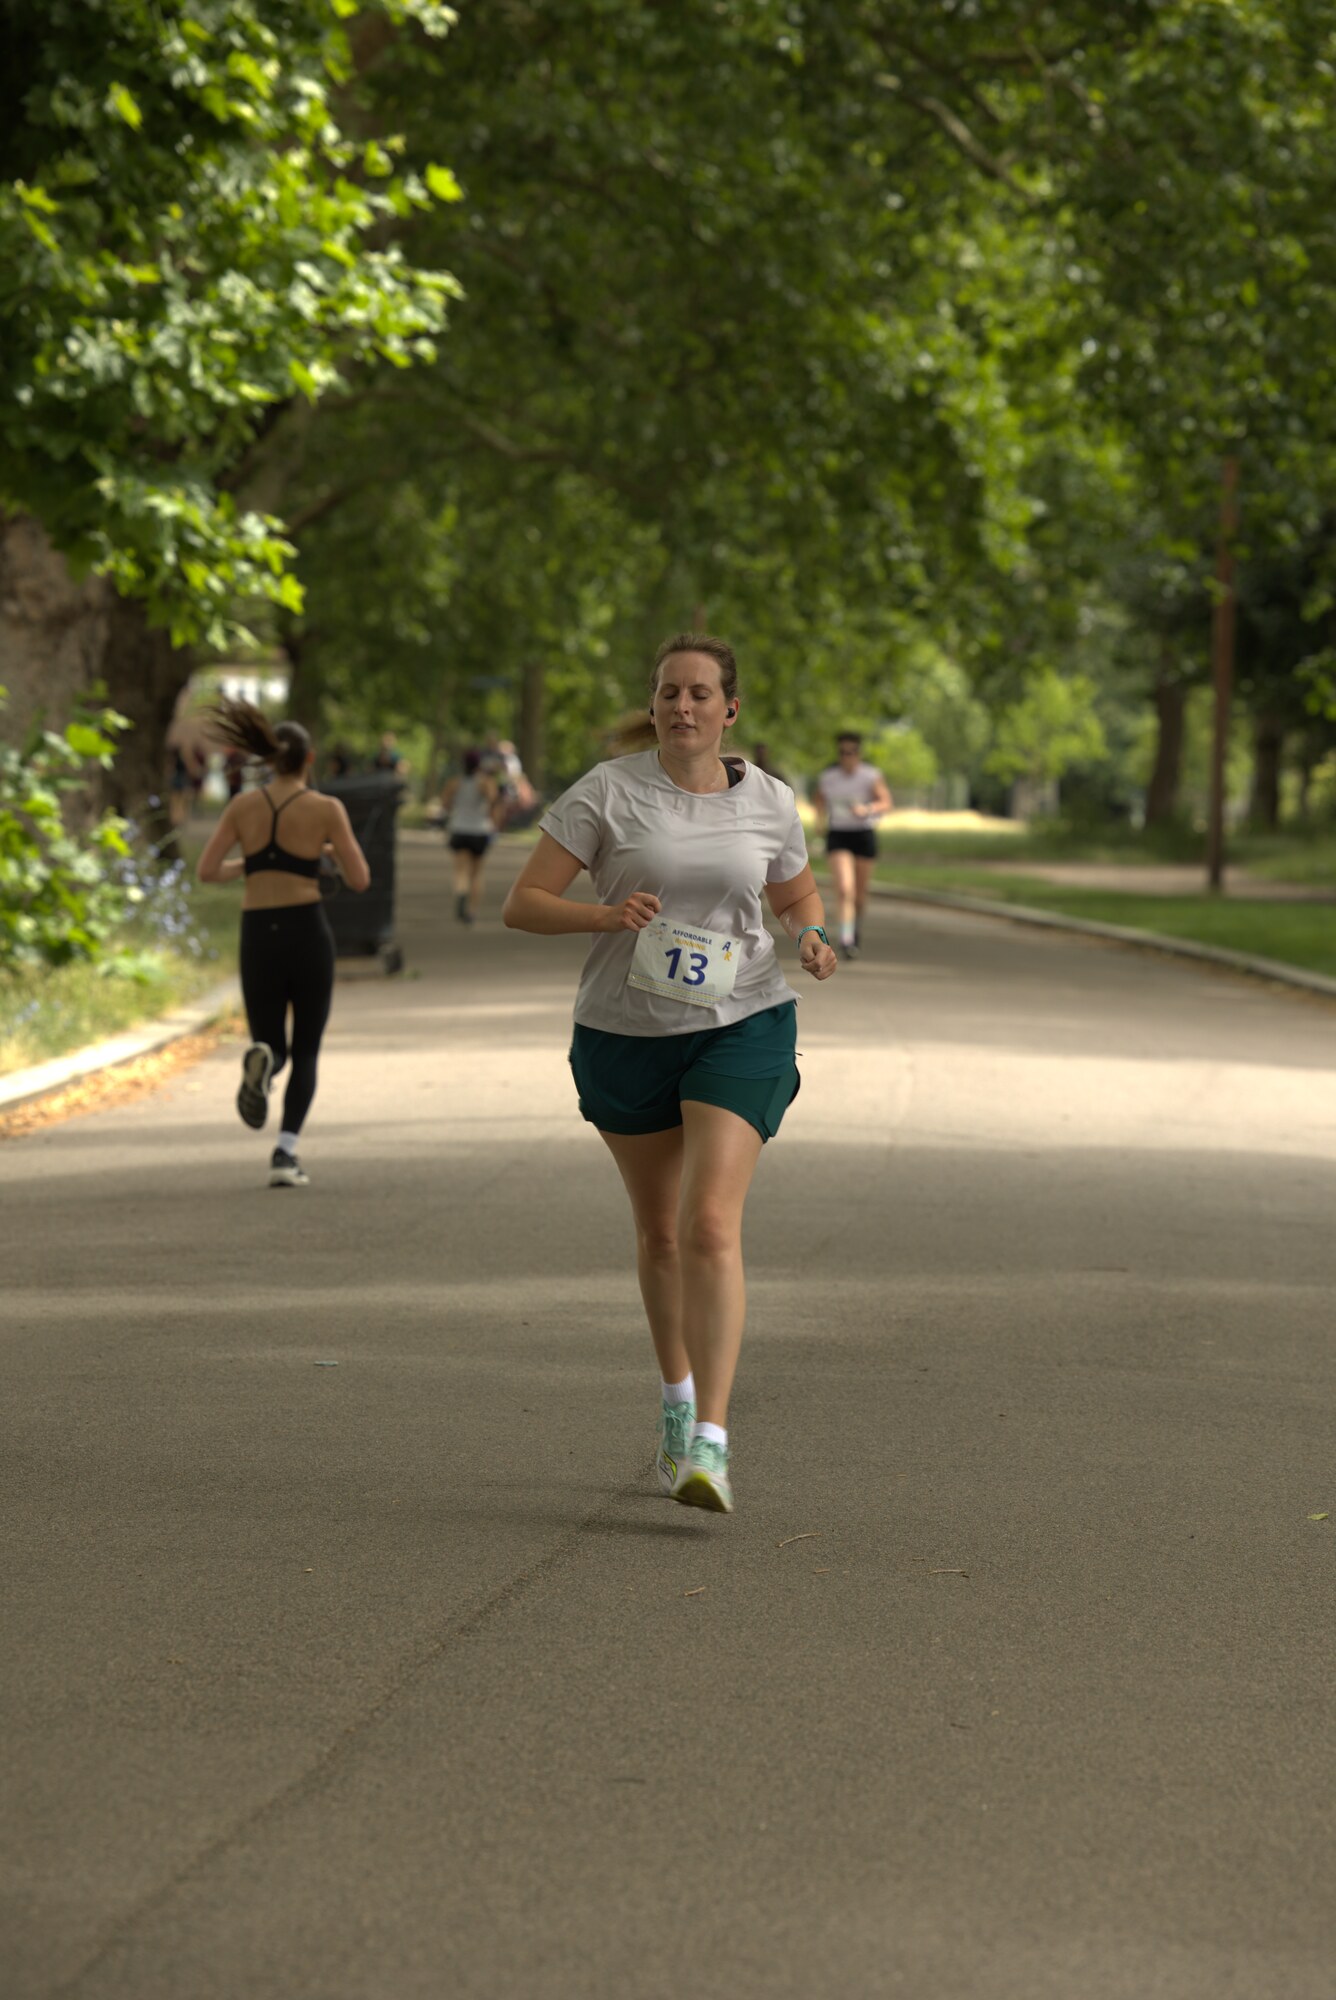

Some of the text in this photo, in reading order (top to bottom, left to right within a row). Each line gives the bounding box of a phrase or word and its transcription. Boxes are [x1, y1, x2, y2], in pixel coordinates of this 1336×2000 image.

[672, 929, 712, 945] AFFORDABLE
[674, 937, 706, 951] RUNNING
[665, 947, 708, 986] 13
